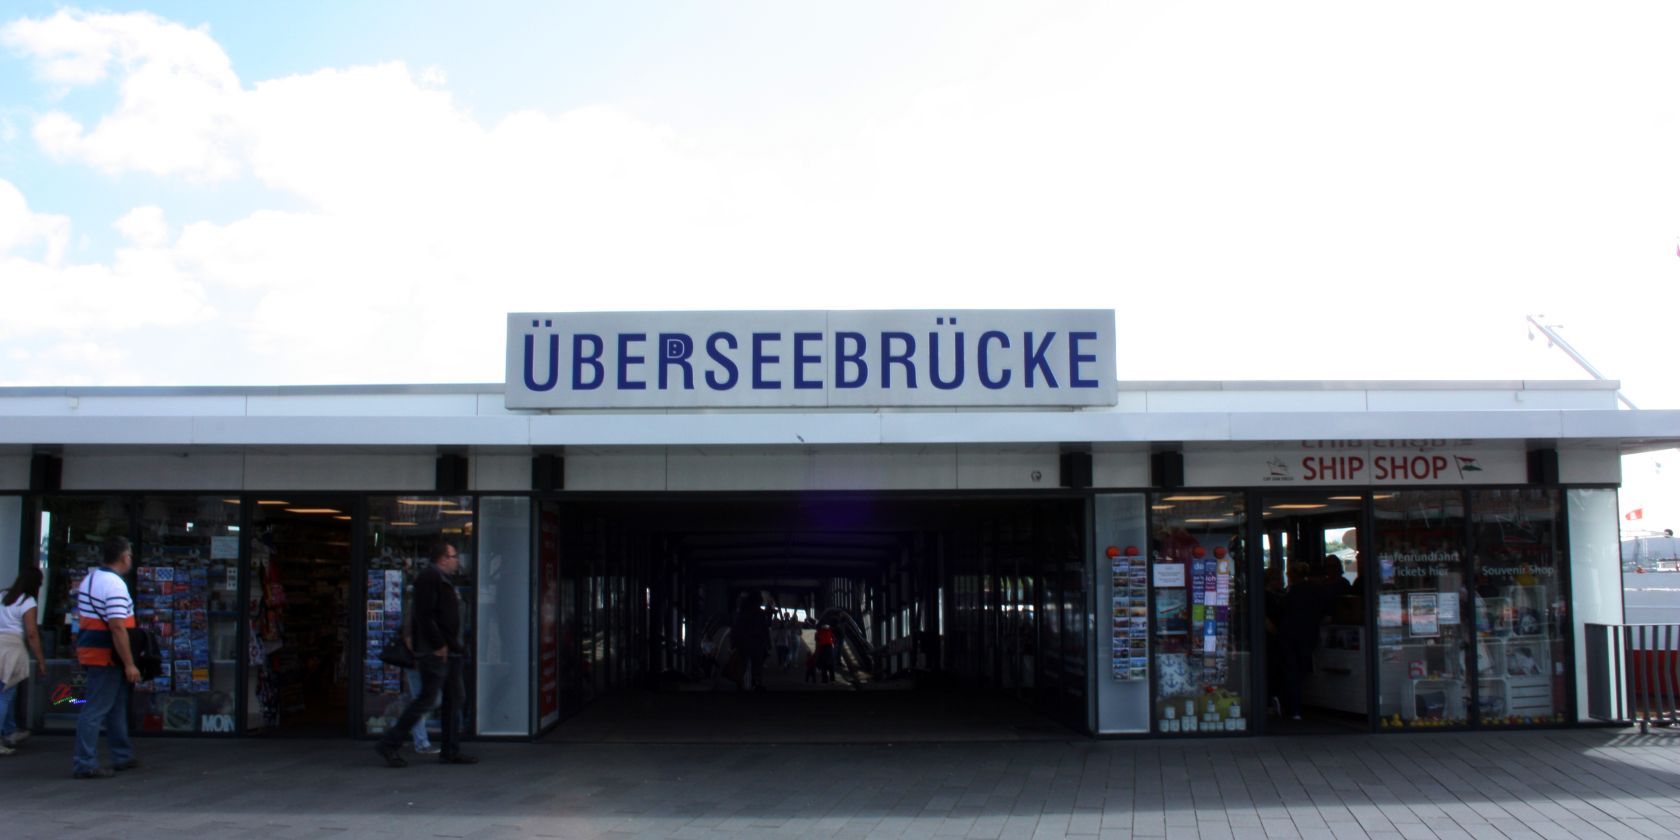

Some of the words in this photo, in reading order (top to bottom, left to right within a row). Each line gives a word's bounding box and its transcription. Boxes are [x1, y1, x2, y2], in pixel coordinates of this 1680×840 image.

[524, 317, 1099, 392] ÜBERSEEBRÜCKE
[1302, 456, 1364, 481] SHIP
[1374, 455, 1448, 480] SHOP
